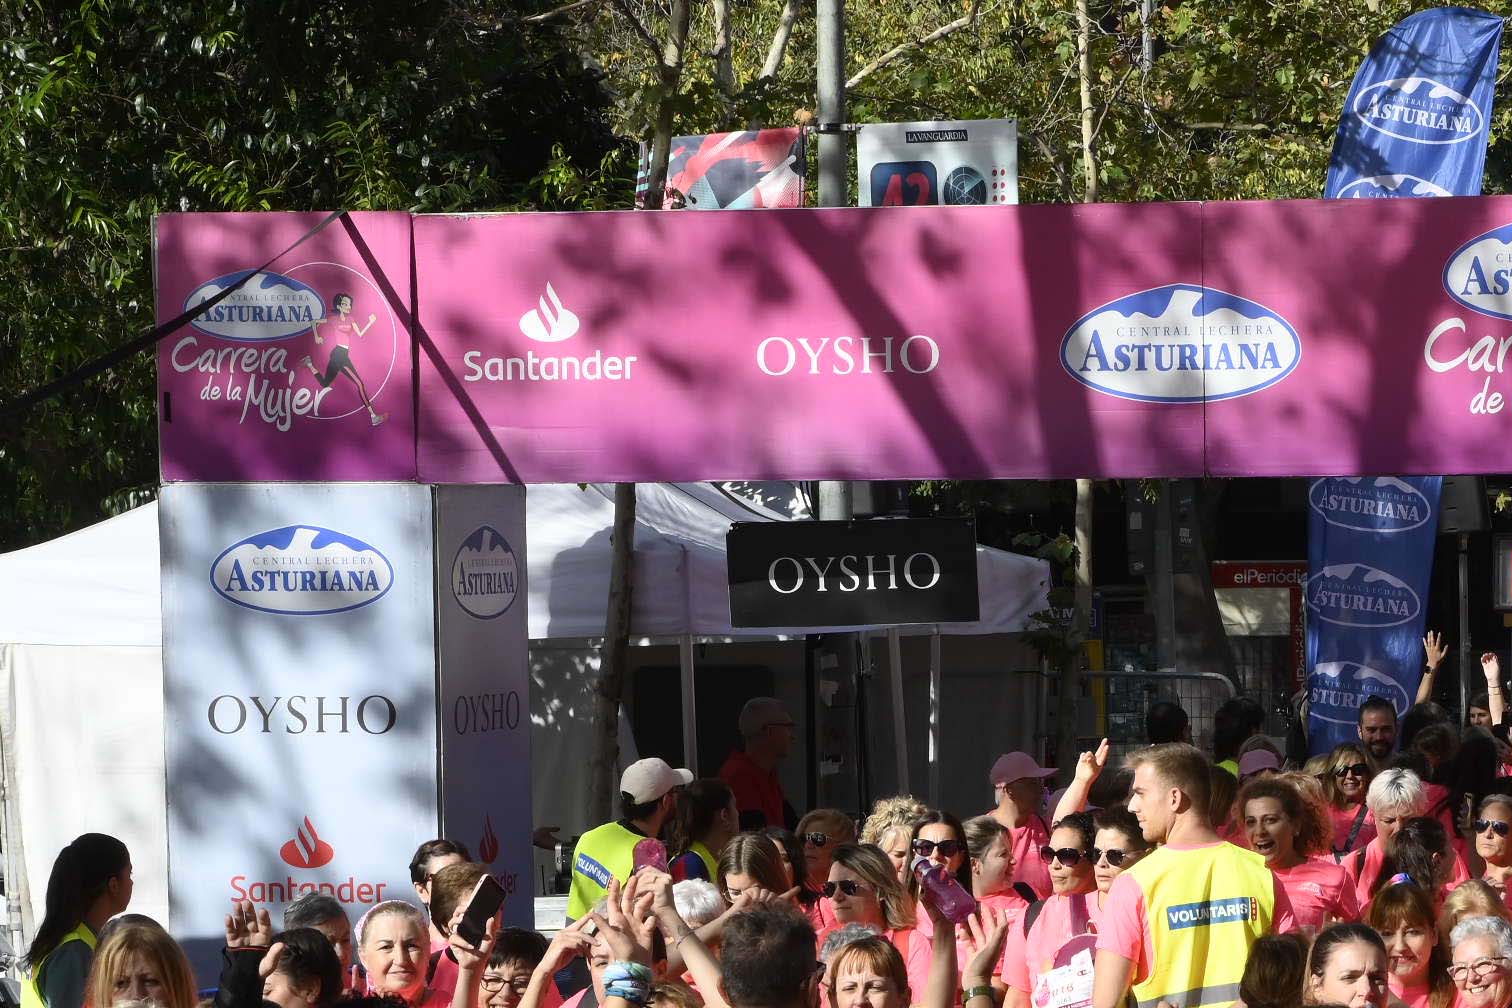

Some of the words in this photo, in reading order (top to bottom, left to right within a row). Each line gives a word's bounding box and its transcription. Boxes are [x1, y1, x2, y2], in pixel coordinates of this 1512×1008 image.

[1364, 94, 1472, 133] ASTURIANA
[908, 132, 918, 142] LA
[918, 131, 967, 142] VANGUARDIA
[194, 296, 313, 323] ASTURIANA
[1115, 324, 1191, 337] CENTRAL
[1197, 324, 1275, 337] LECHERA
[171, 336, 288, 374] Carrera
[463, 350, 637, 382] Santander
[756, 336, 940, 379] OYSHO
[1079, 329, 1282, 374] ASTURIANA
[200, 376, 222, 401] de
[226, 376, 242, 401] la
[239, 371, 333, 432] Mujer
[1470, 376, 1504, 415] de
[1318, 485, 1420, 521] ASTURIANA
[224, 558, 380, 593] ASTURIANA
[252, 556, 313, 566] CENTRAL
[314, 556, 375, 565] LECHERA
[457, 562, 515, 595] ASTURIANA
[768, 552, 942, 594] OYSHO
[1233, 568, 1304, 585] elPeriódi
[1312, 580, 1410, 617] ASTURIANA
[207, 694, 397, 735] OYSHO
[454, 690, 520, 735] OYSHO
[230, 875, 387, 903] Santander
[1168, 902, 1248, 924] VOLUNTARIS
